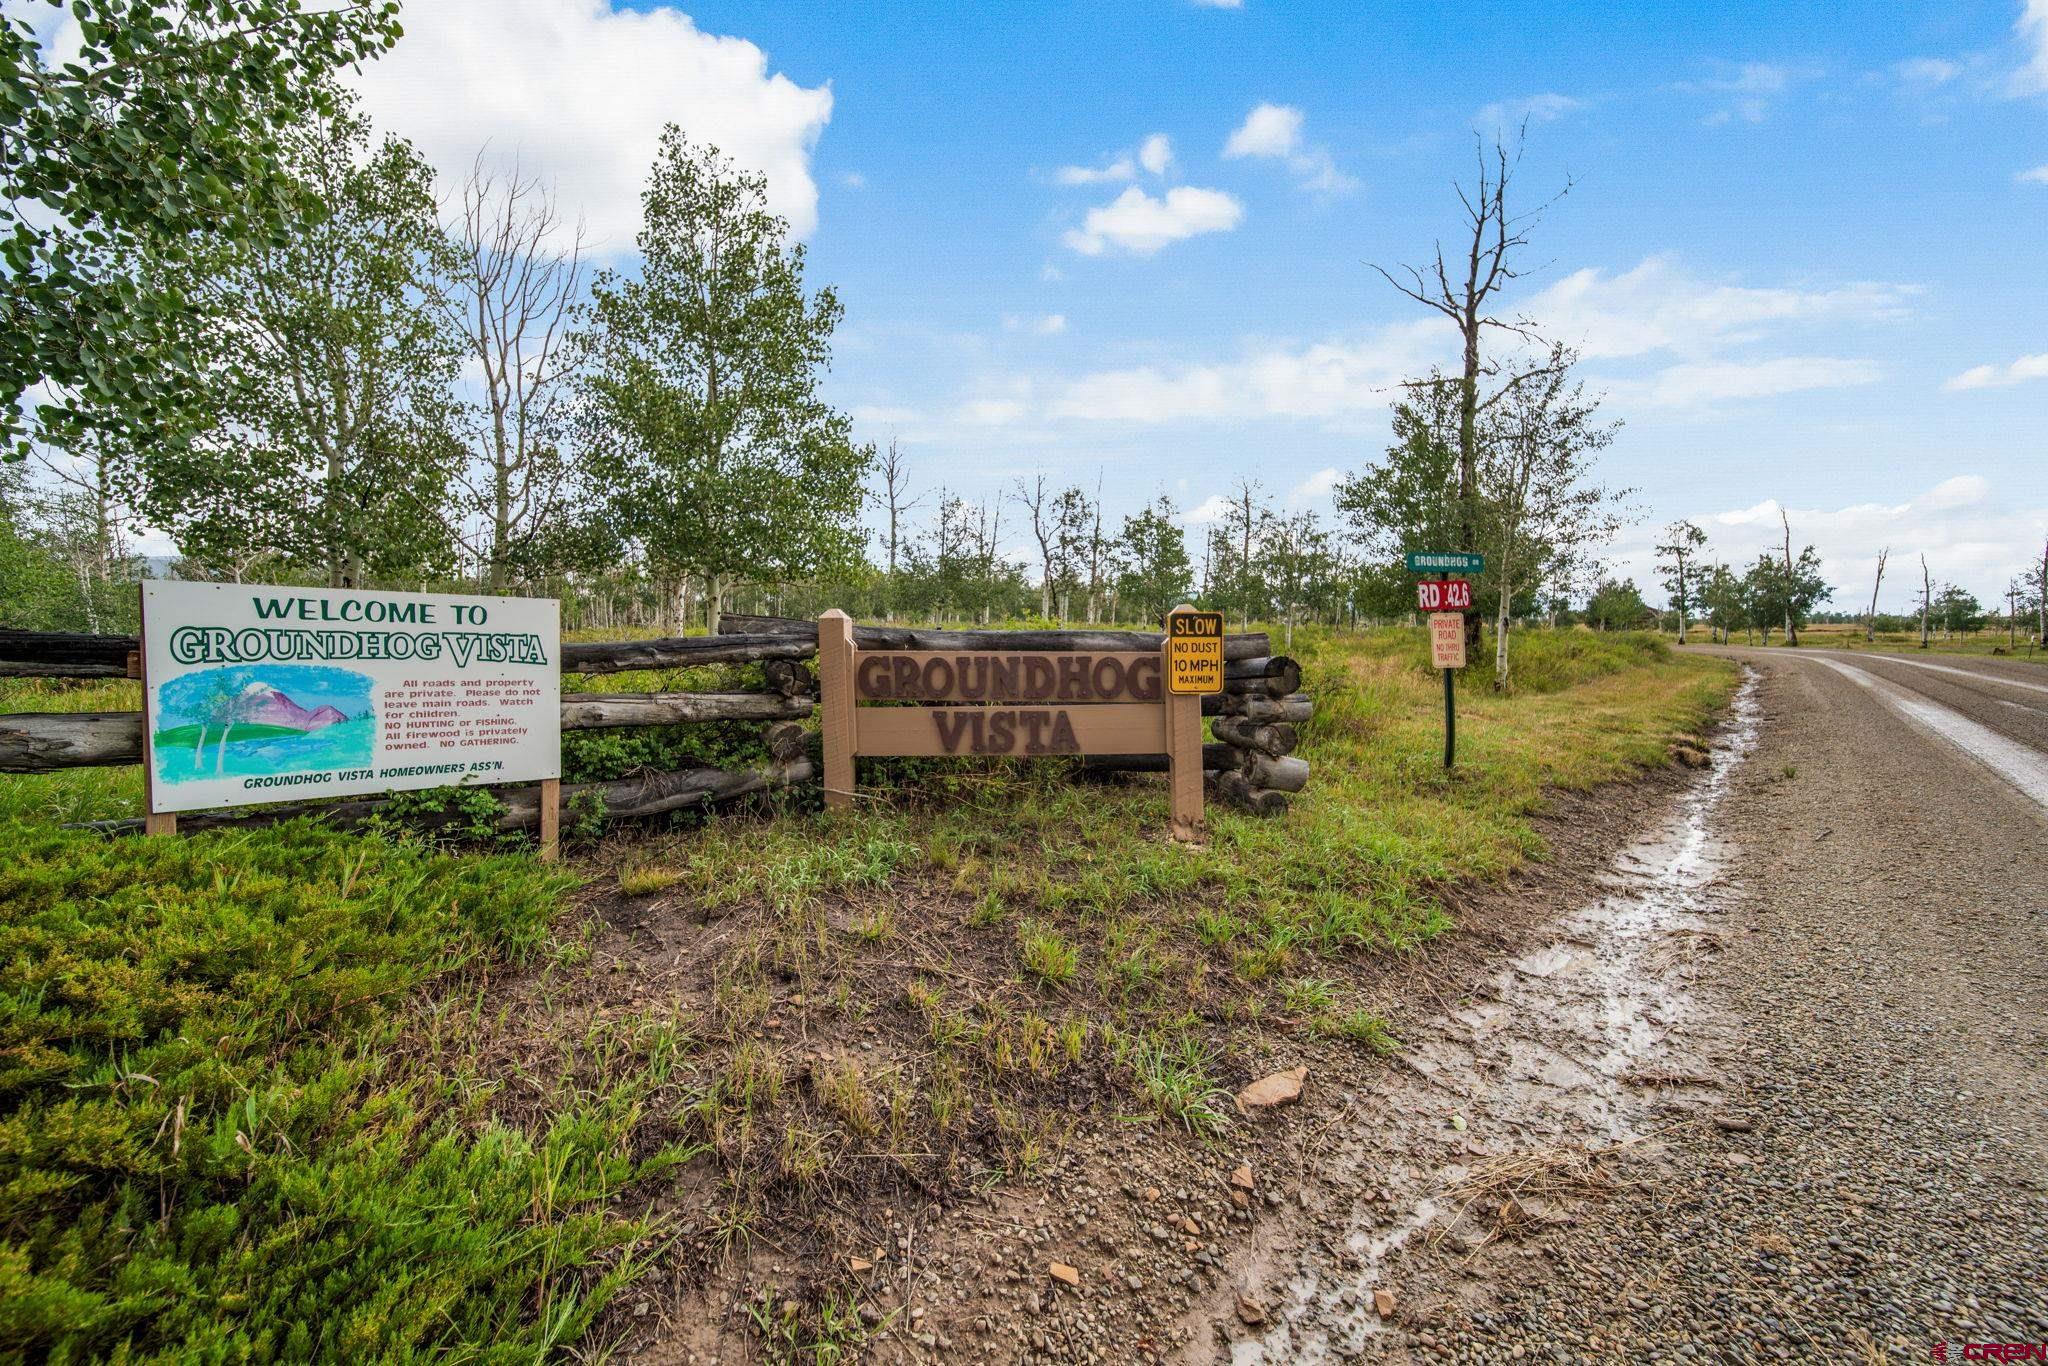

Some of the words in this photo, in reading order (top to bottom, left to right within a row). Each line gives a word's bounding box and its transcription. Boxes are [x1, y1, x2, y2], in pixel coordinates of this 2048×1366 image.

[1414, 556, 1468, 567] GROUNDHOG
[1418, 584, 1439, 608] RD
[1448, 583, 1469, 607] 42.6
[252, 598, 436, 624] WELCOME
[450, 604, 488, 625] TO
[1175, 618, 1216, 635] SLOW
[1434, 620, 1460, 629] PRIVATE
[1439, 631, 1456, 639] ROAD
[170, 626, 441, 664] GROUNDHOG
[442, 632, 547, 668] VISTA
[1174, 643, 1188, 653] NO
[1191, 642, 1217, 653] DUST
[1446, 643, 1459, 651] THRU
[1438, 653, 1459, 661] TRAFFIC
[1174, 660, 1186, 672] 10
[1190, 660, 1218, 672] MPH
[858, 655, 1161, 699] GROUNDHOG
[1178, 675, 1214, 684] MAXIMUM
[402, 679, 419, 687] All
[423, 679, 457, 687] roads
[460, 679, 482, 687] and
[485, 679, 534, 689] property
[384, 690, 406, 698] are
[409, 689, 456, 699] private.
[466, 688, 502, 697] Please
[505, 688, 519, 697] do
[522, 688, 541, 696] not
[384, 700, 418, 708] leave
[422, 699, 451, 708] main
[455, 699, 490, 708] roads.
[499, 698, 534, 706] Watch
[385, 710, 404, 719] for
[408, 709, 459, 719] children.
[384, 721, 401, 729] NO
[408, 720, 455, 729] HUNTING
[460, 720, 472, 728] or
[476, 718, 517, 727] FISHING.
[385, 732, 402, 740] All
[406, 730, 461, 739] firewood
[465, 728, 474, 736] is
[478, 727, 528, 738] privately
[932, 710, 1080, 753] VISTA
[385, 741, 430, 750] owned.
[440, 740, 455, 748] NO
[460, 737, 519, 747] GATHERING.
[243, 773, 331, 789] GROUNDHOG
[338, 769, 374, 781] VISTA
[380, 763, 465, 778] HOMEOWNERS
[469, 760, 504, 772] ASS'N.
